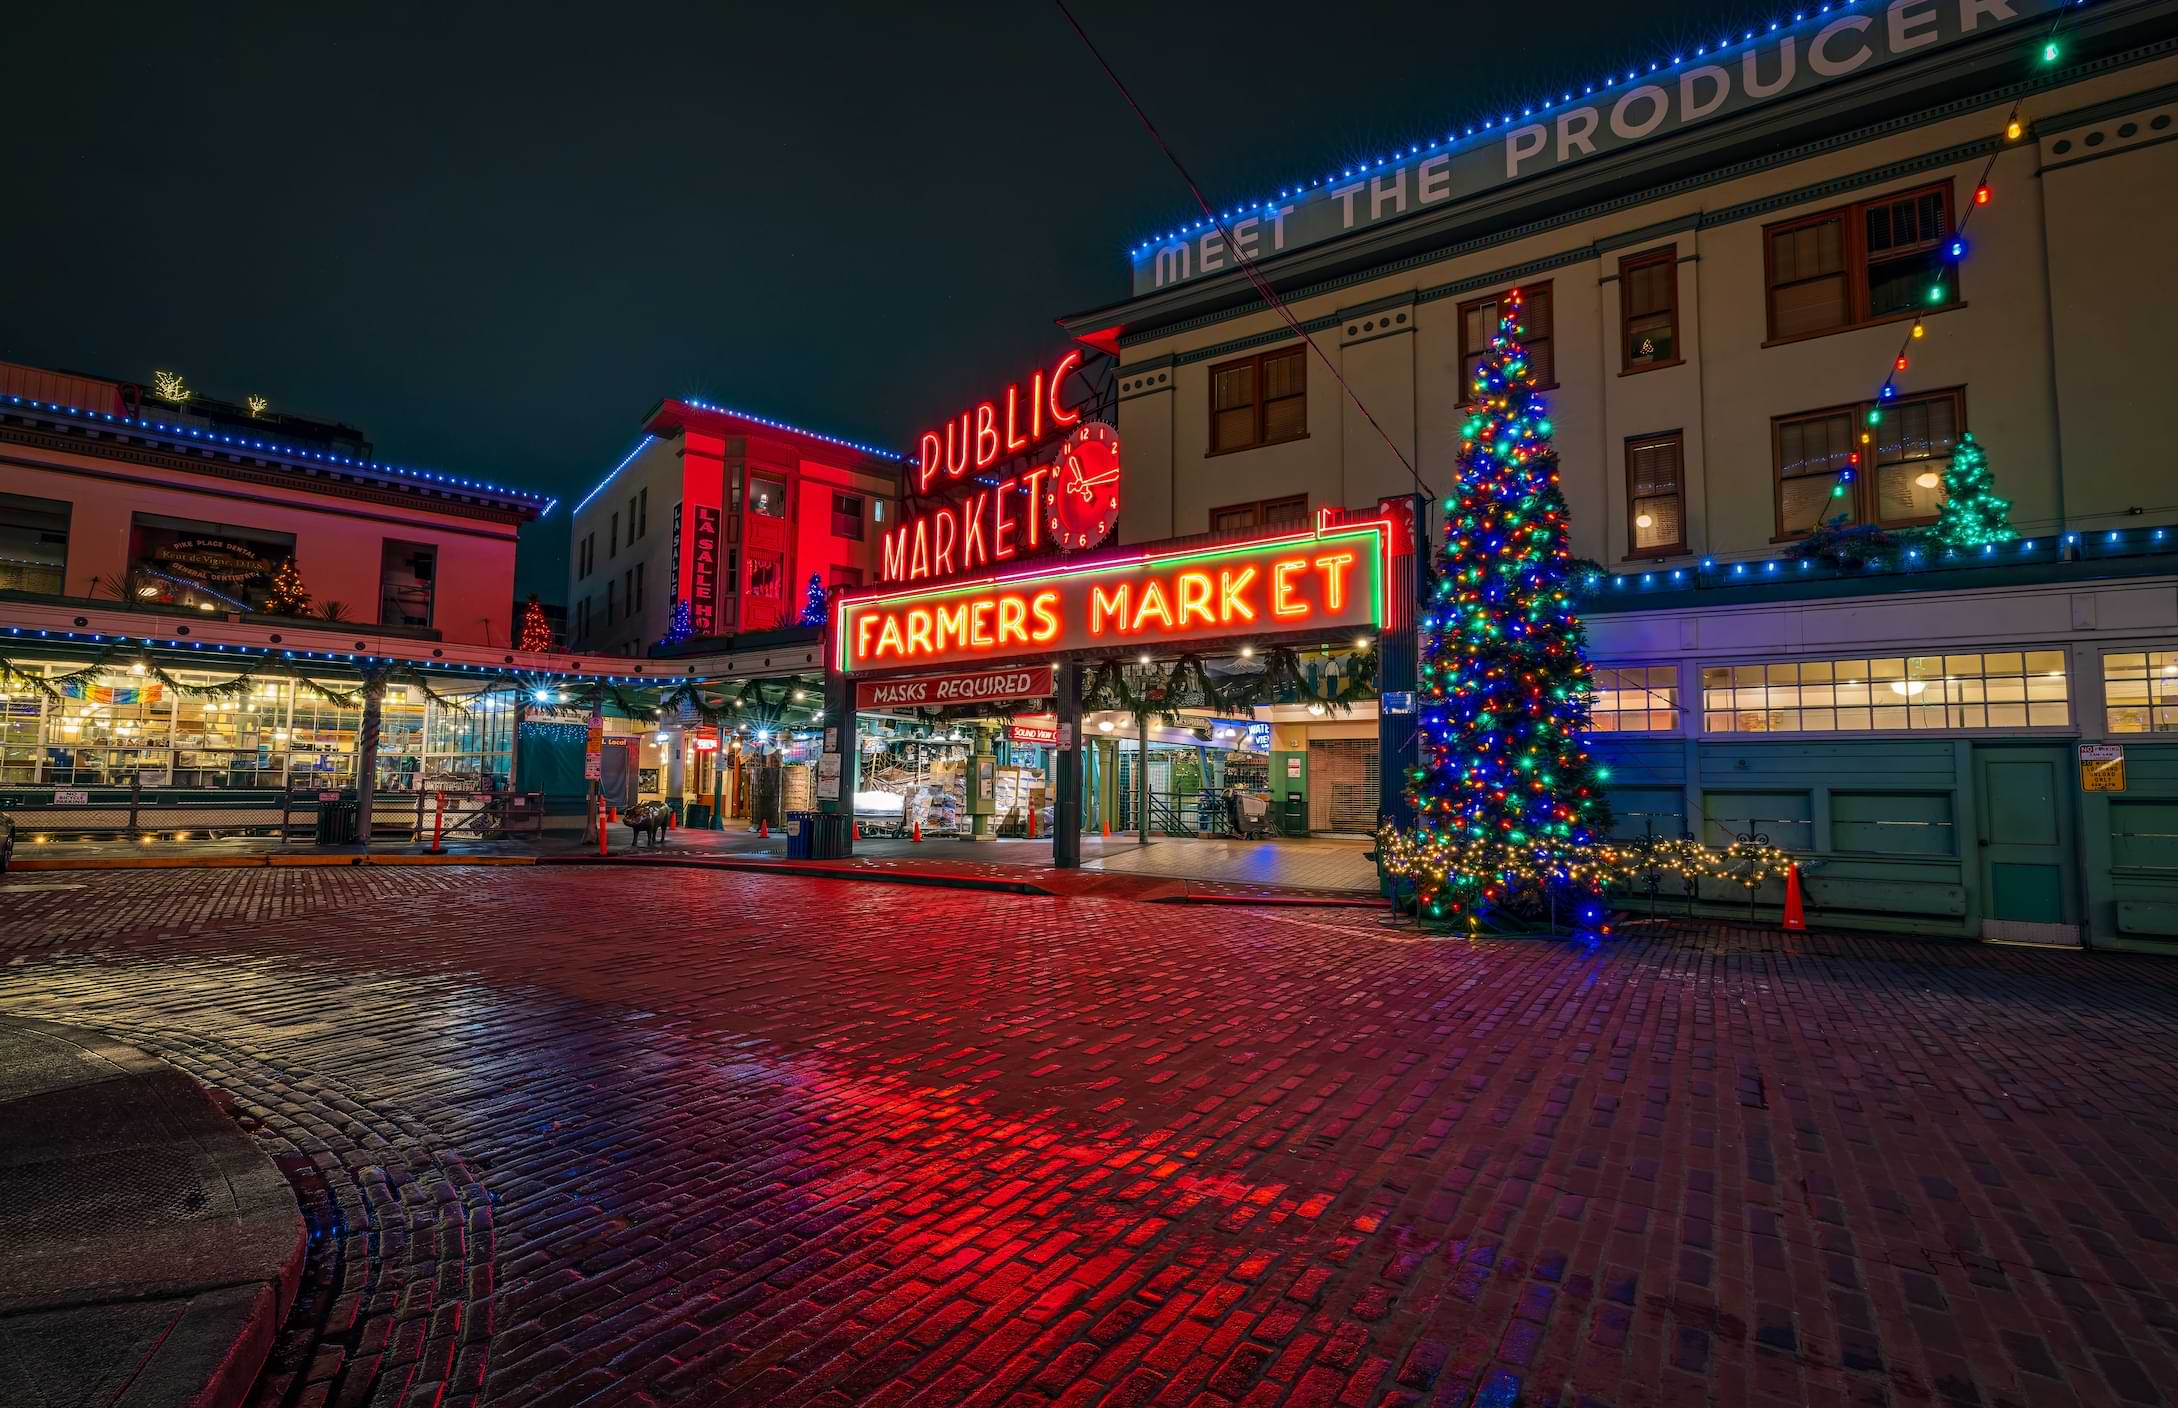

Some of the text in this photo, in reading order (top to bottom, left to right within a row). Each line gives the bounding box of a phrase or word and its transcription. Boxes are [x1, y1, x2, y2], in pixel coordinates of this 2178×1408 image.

[1155, 206, 1294, 288] MEET
[1331, 153, 1450, 229] THE
[920, 351, 1081, 493] PUBLIC
[1080, 428, 1089, 441] 12
[1099, 428, 1104, 440] 1
[1064, 443, 1071, 455] 11
[1111, 442, 1118, 455] 2
[1047, 494, 1054, 505] 9
[1110, 497, 1117, 509] 4
[882, 467, 1049, 582] MARKET
[1051, 518, 1058, 529] 8
[1098, 521, 1105, 534] 5
[1064, 532, 1070, 543] 7
[1079, 534, 1086, 547] 6
[174, 540, 256, 560] PIKE PLACE DENTAL
[172, 562, 257, 582] GENERAL DENTISTRY
[857, 554, 1354, 658] FARMERS MARKET
[873, 673, 1031, 703] MASKS REQUIRED
[1014, 727, 1037, 737] SOUND
[1037, 729, 1052, 739] VIEW
[1249, 724, 1269, 735] WATE
[608, 738, 627, 746] Local
